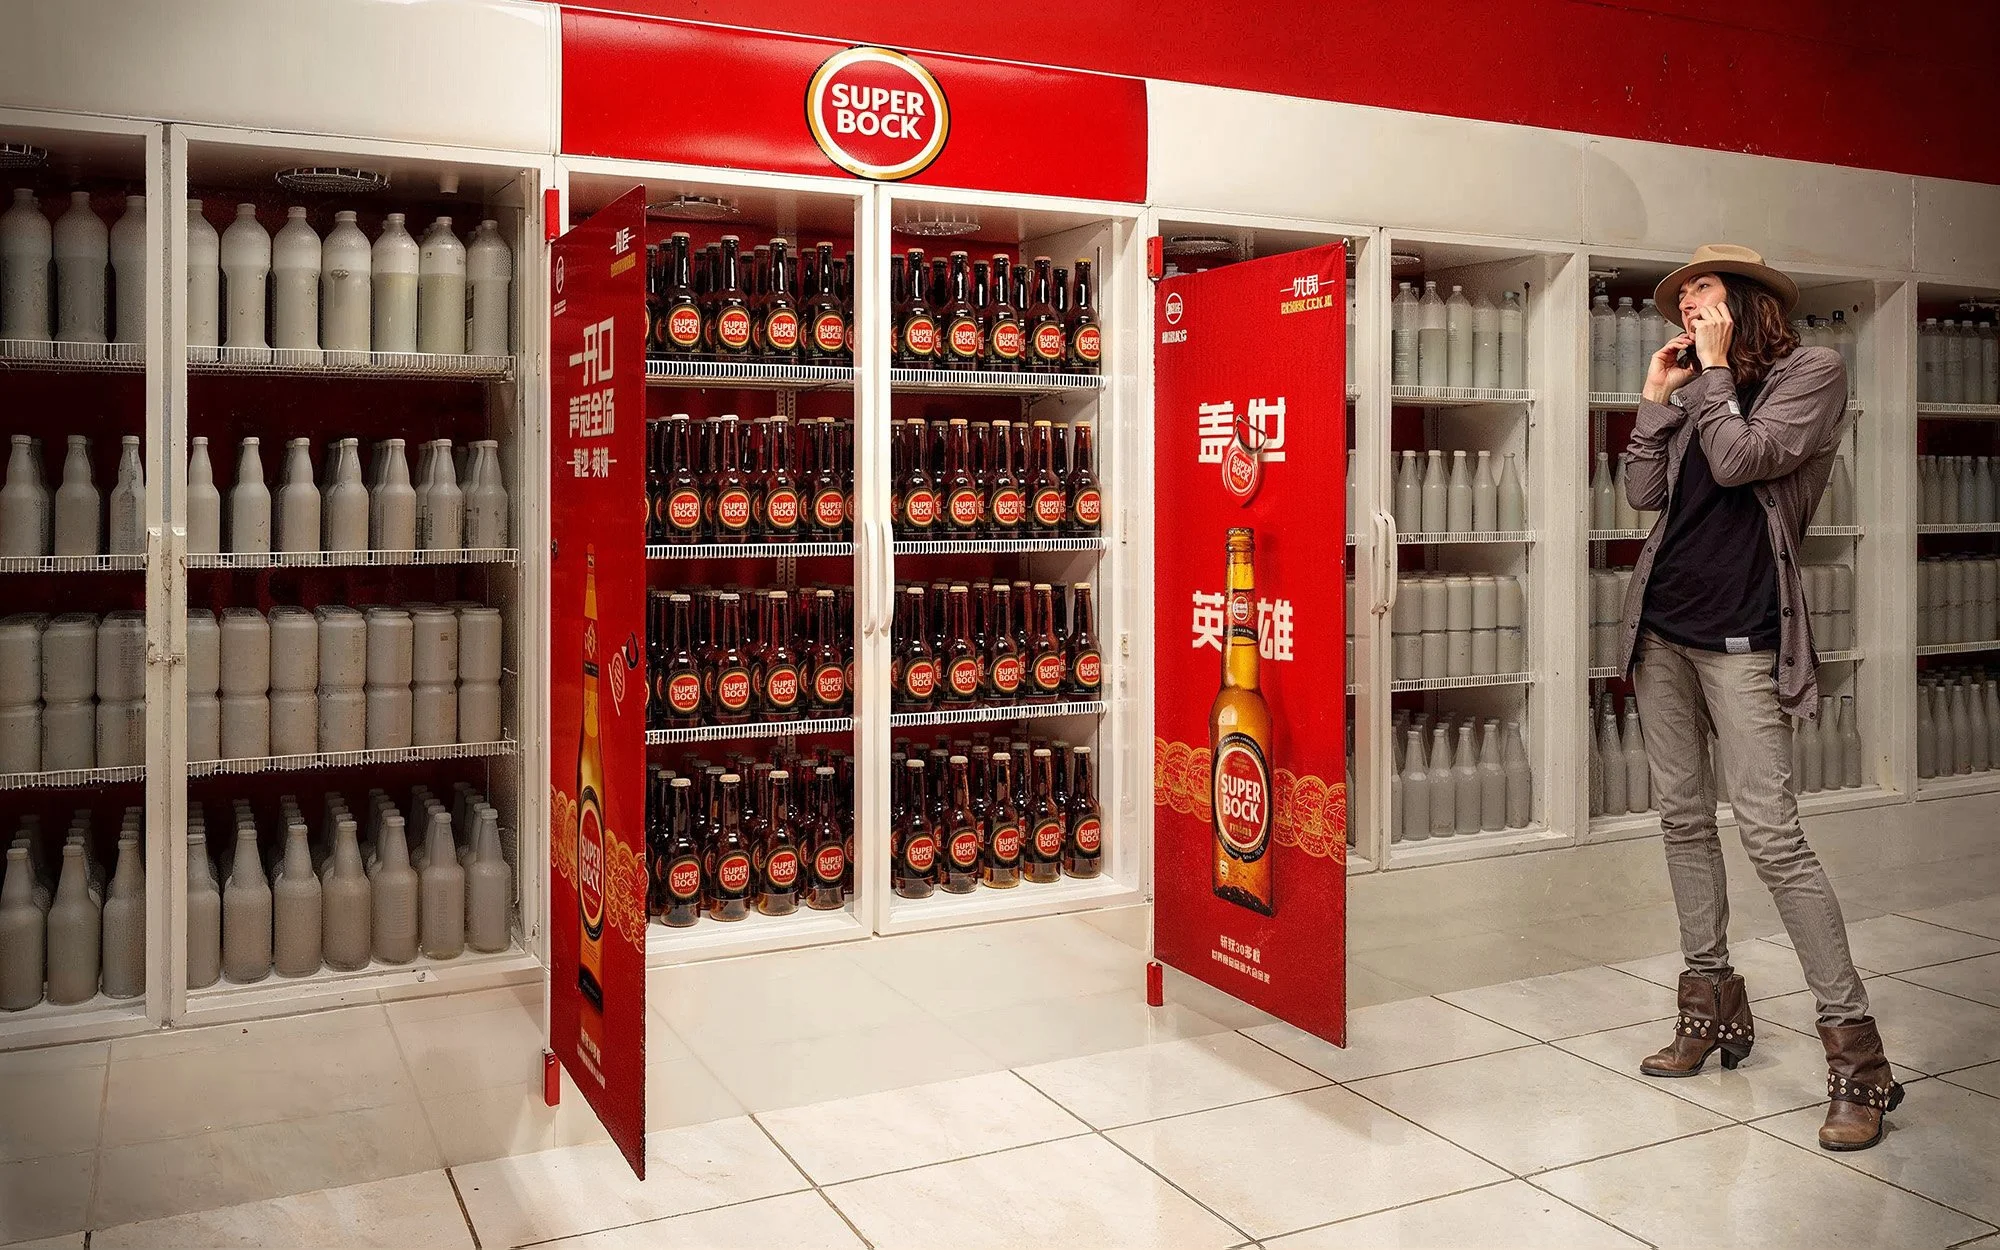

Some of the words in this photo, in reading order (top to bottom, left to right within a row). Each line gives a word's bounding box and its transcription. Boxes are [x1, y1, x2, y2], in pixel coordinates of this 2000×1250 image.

[831, 83, 926, 116] SUPER
[836, 108, 922, 140] BOCK
[672, 319, 698, 327] SUPER
[724, 321, 748, 329] SUPER
[772, 323, 796, 331] SUPER
[674, 326, 698, 334] BOCK
[724, 328, 748, 336] BOCK
[820, 325, 842, 333] SUPER
[773, 330, 796, 338] BOCK
[820, 332, 842, 340] BOCK
[820, 502, 842, 510] SUPER
[773, 509, 796, 517] BOCK
[724, 683, 748, 691] SUPER
[772, 680, 796, 688] SUPER
[820, 684, 842, 692] BOCK
[672, 685, 698, 694] SUPER
[773, 687, 796, 695] BOCK
[674, 693, 698, 701] BOCK
[724, 690, 748, 698] BOCK
[1221, 773, 1261, 803] SUPER
[1223, 794, 1260, 824] BOCK
[820, 855, 842, 864] SUPER
[772, 861, 796, 869] SUPER
[820, 862, 842, 871] BOCK
[724, 866, 748, 874] SUPER
[773, 868, 796, 876] BOCK
[672, 871, 698, 880] SUPER
[724, 873, 748, 882] BOCK
[674, 878, 698, 887] BOCK
